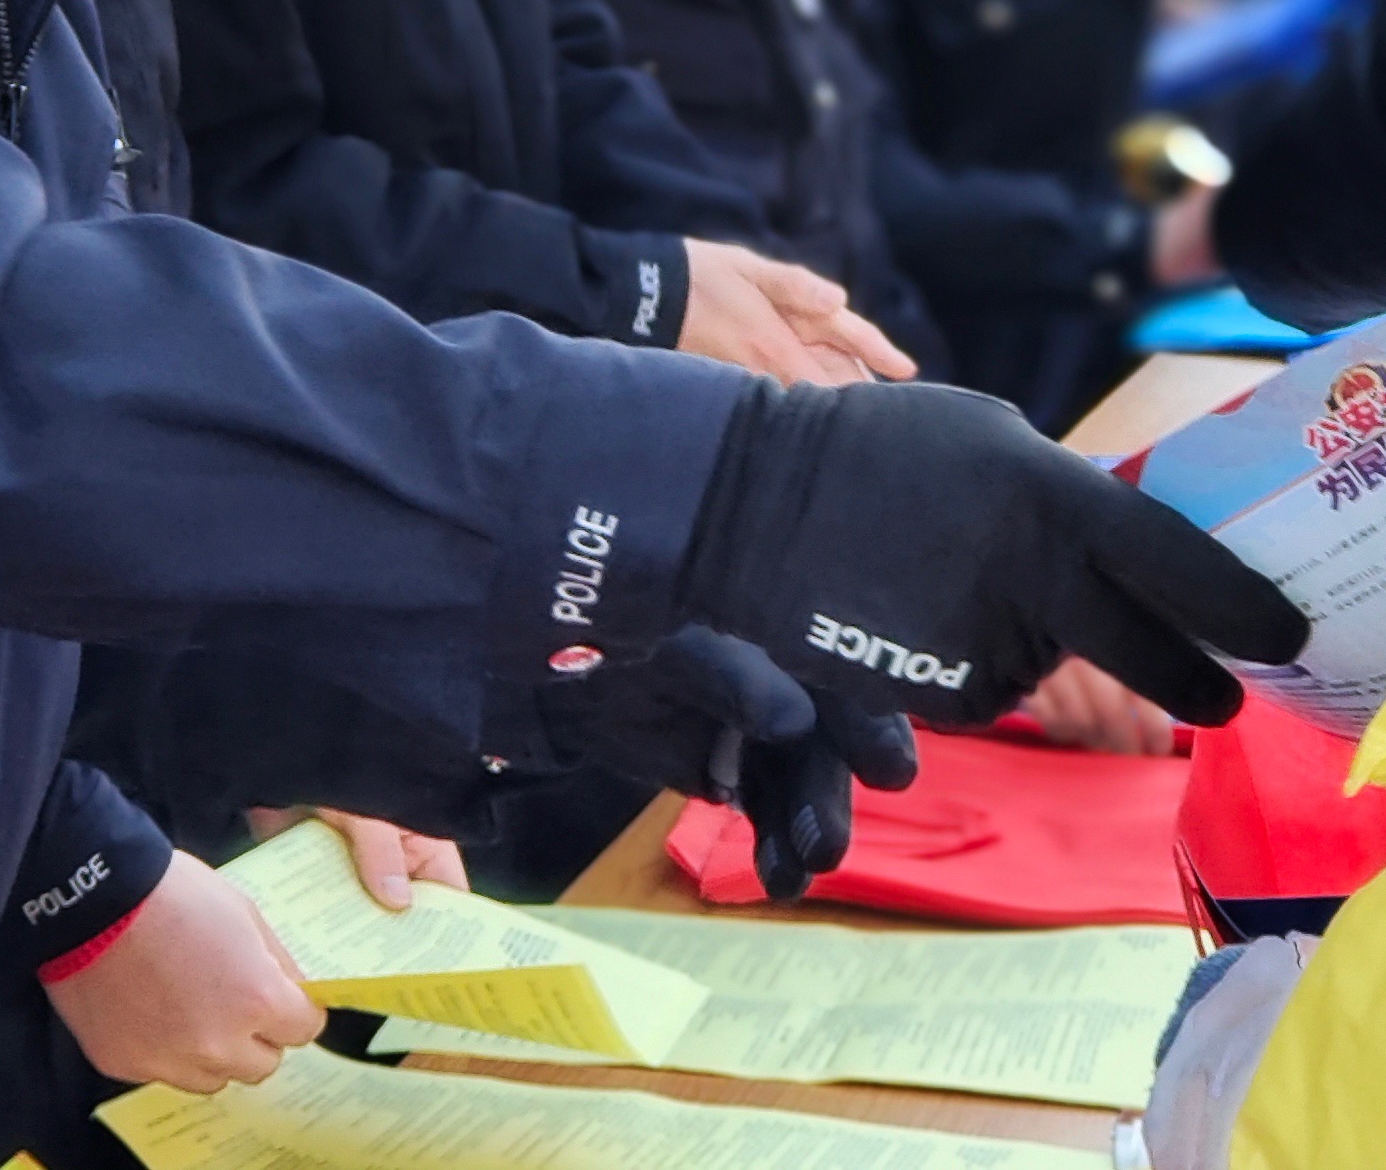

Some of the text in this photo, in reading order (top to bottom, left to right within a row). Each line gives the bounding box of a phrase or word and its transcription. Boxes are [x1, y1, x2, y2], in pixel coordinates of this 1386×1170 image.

[551, 505, 619, 625] POLICE
[807, 612, 973, 690] POLICE
[22, 852, 111, 926] POLICE
